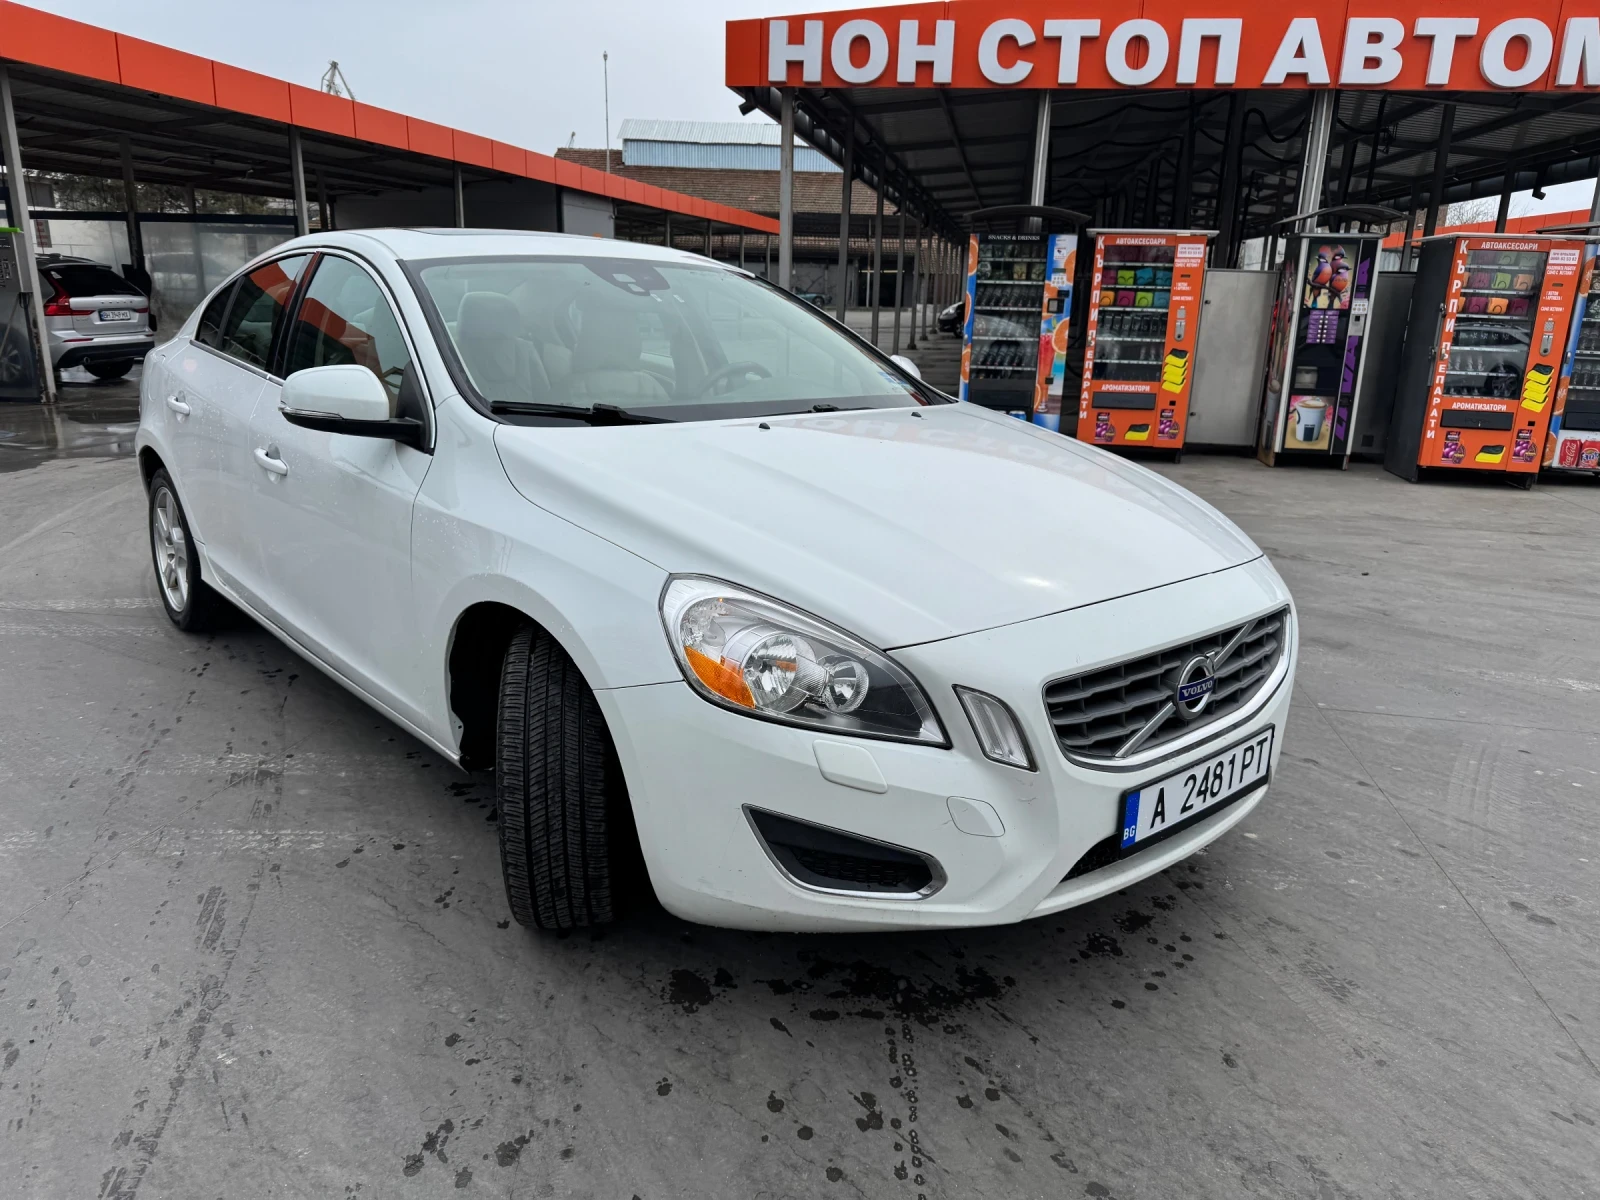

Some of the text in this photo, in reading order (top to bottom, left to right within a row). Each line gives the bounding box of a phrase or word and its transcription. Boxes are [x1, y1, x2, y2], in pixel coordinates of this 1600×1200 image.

[768, 19, 955, 84] НОН
[978, 18, 1242, 86] СТОП
[1481, 241, 1538, 250] АВТОАКСЕСОАРИ
[1090, 236, 1105, 322] КЪРПИ
[1445, 239, 1469, 333] КЪРПИ
[1101, 384, 1151, 392] АРОМАТИЗАТОРИ
[1452, 402, 1507, 411] АРОМАТИЗАТОРИ
[1181, 680, 1213, 697] VOLVO
[1150, 787, 1166, 829] A
[1123, 825, 1136, 841] BG
